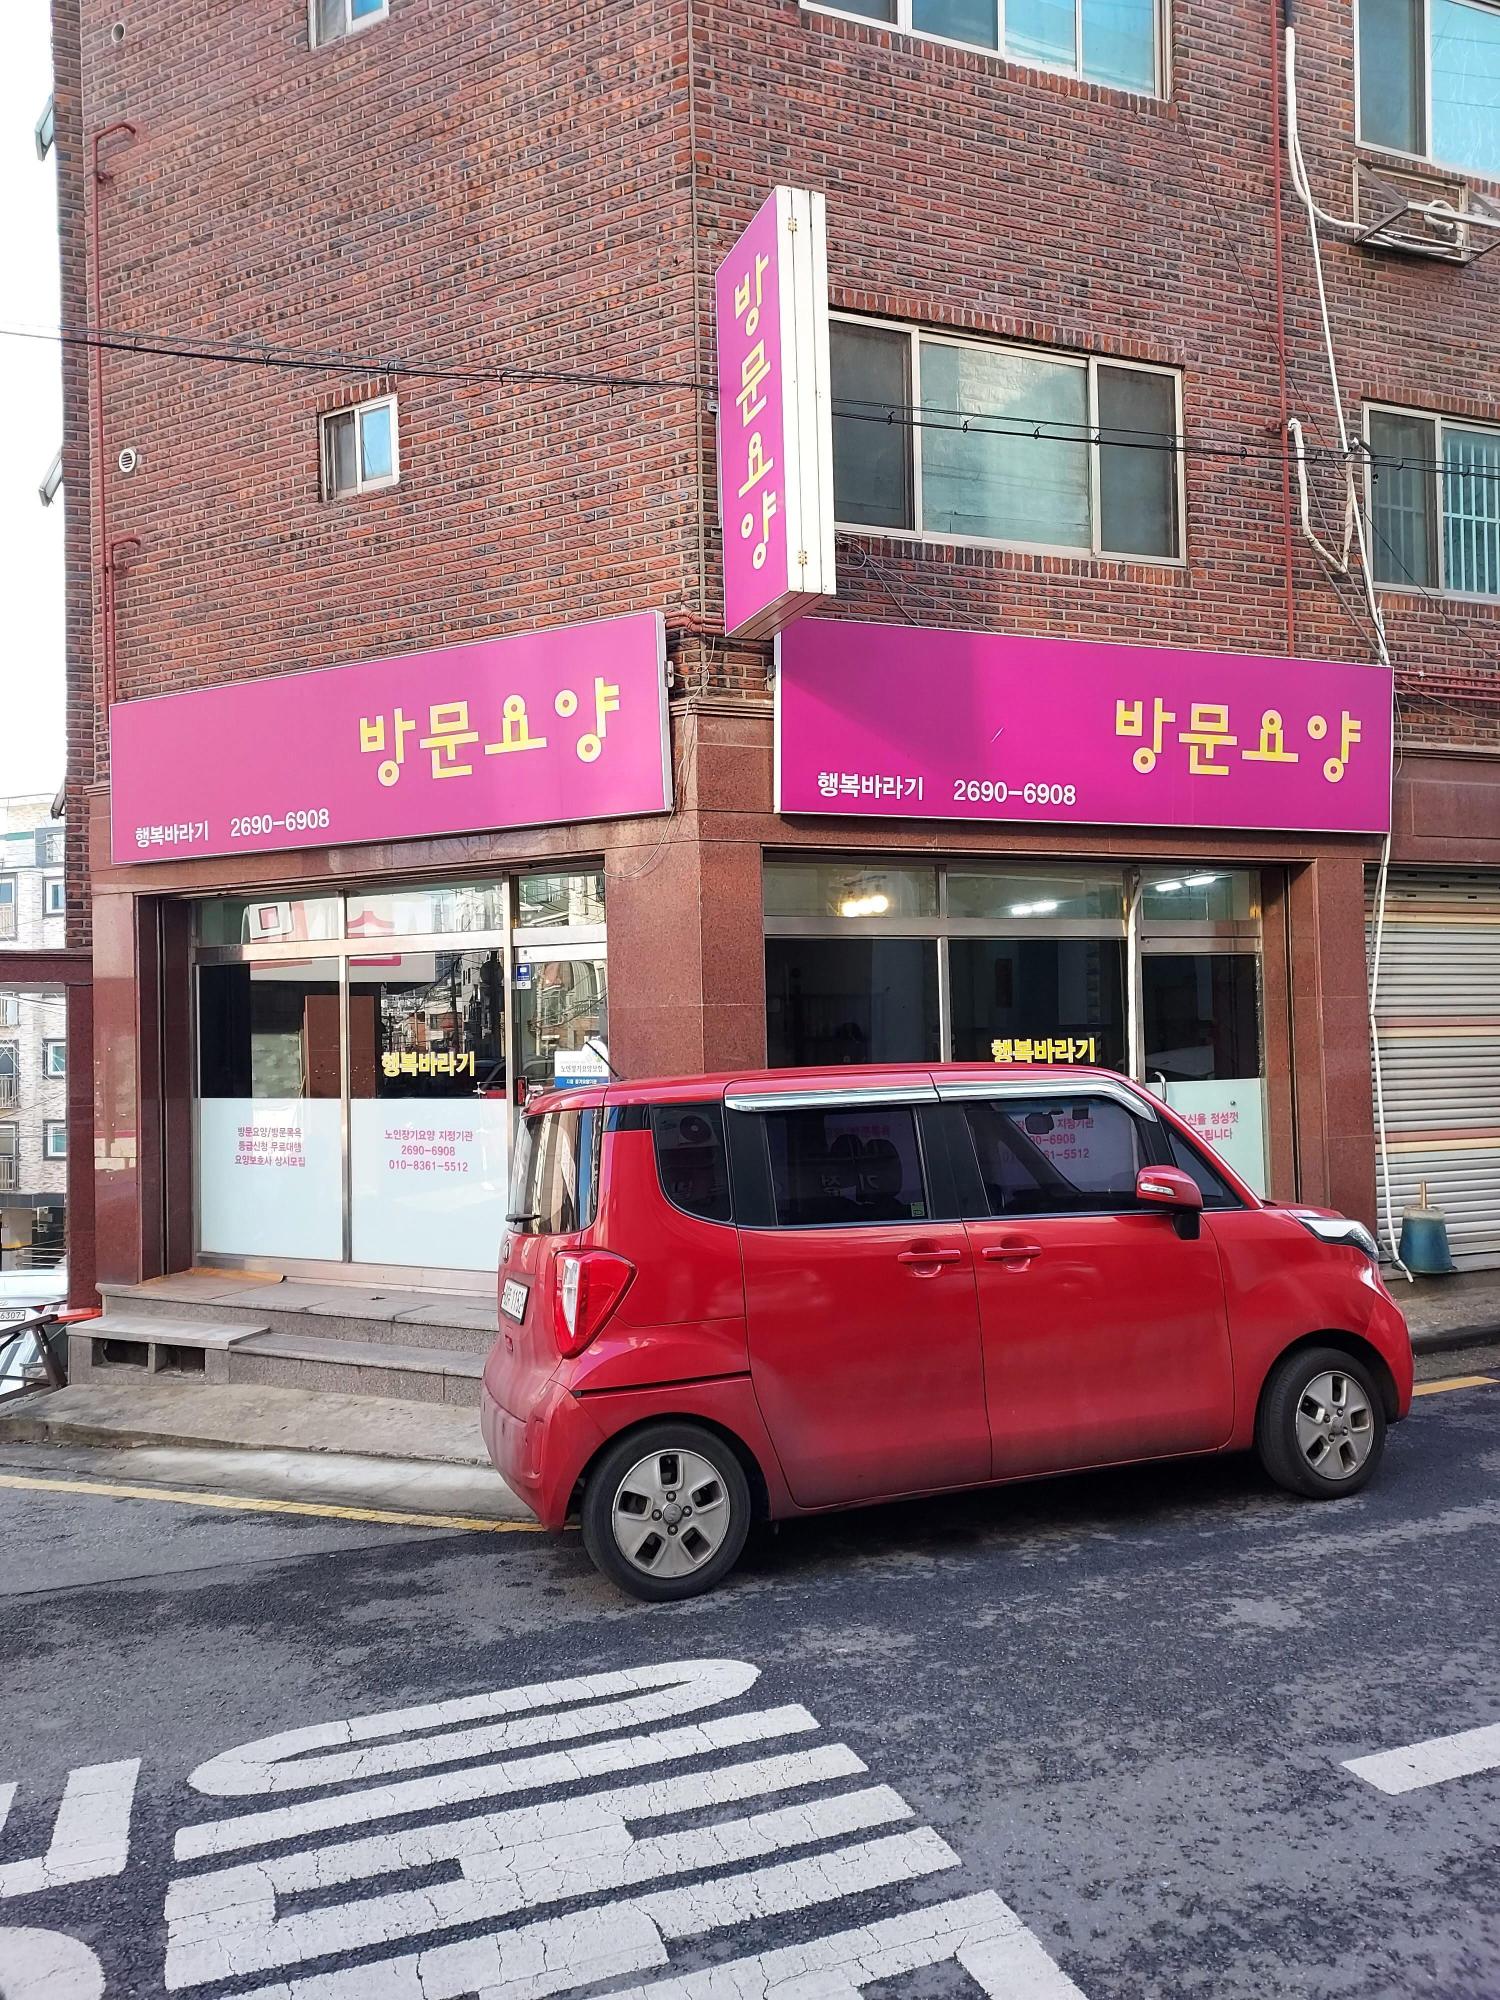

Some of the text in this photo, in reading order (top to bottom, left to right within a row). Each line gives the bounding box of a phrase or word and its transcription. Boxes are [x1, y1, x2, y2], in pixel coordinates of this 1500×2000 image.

[735, 252, 777, 570] 방문요양
[359, 677, 620, 787] 방문요양
[1115, 697, 1362, 783] 방문요양
[817, 772, 1077, 805] 행복바라기 2690-6908
[135, 808, 330, 848] 행복바라기 2690-6908
[381, 1051, 475, 1077] 행복바라기
[991, 1037, 1096, 1064] 행복바라기
[1210, 1111, 1239, 1125] 정성껏
[384, 1129, 474, 1142] 노인장기요양 지정기관
[401, 1145, 456, 1156] 2690-6908
[388, 1159, 469, 1172] 010-8361-5512
